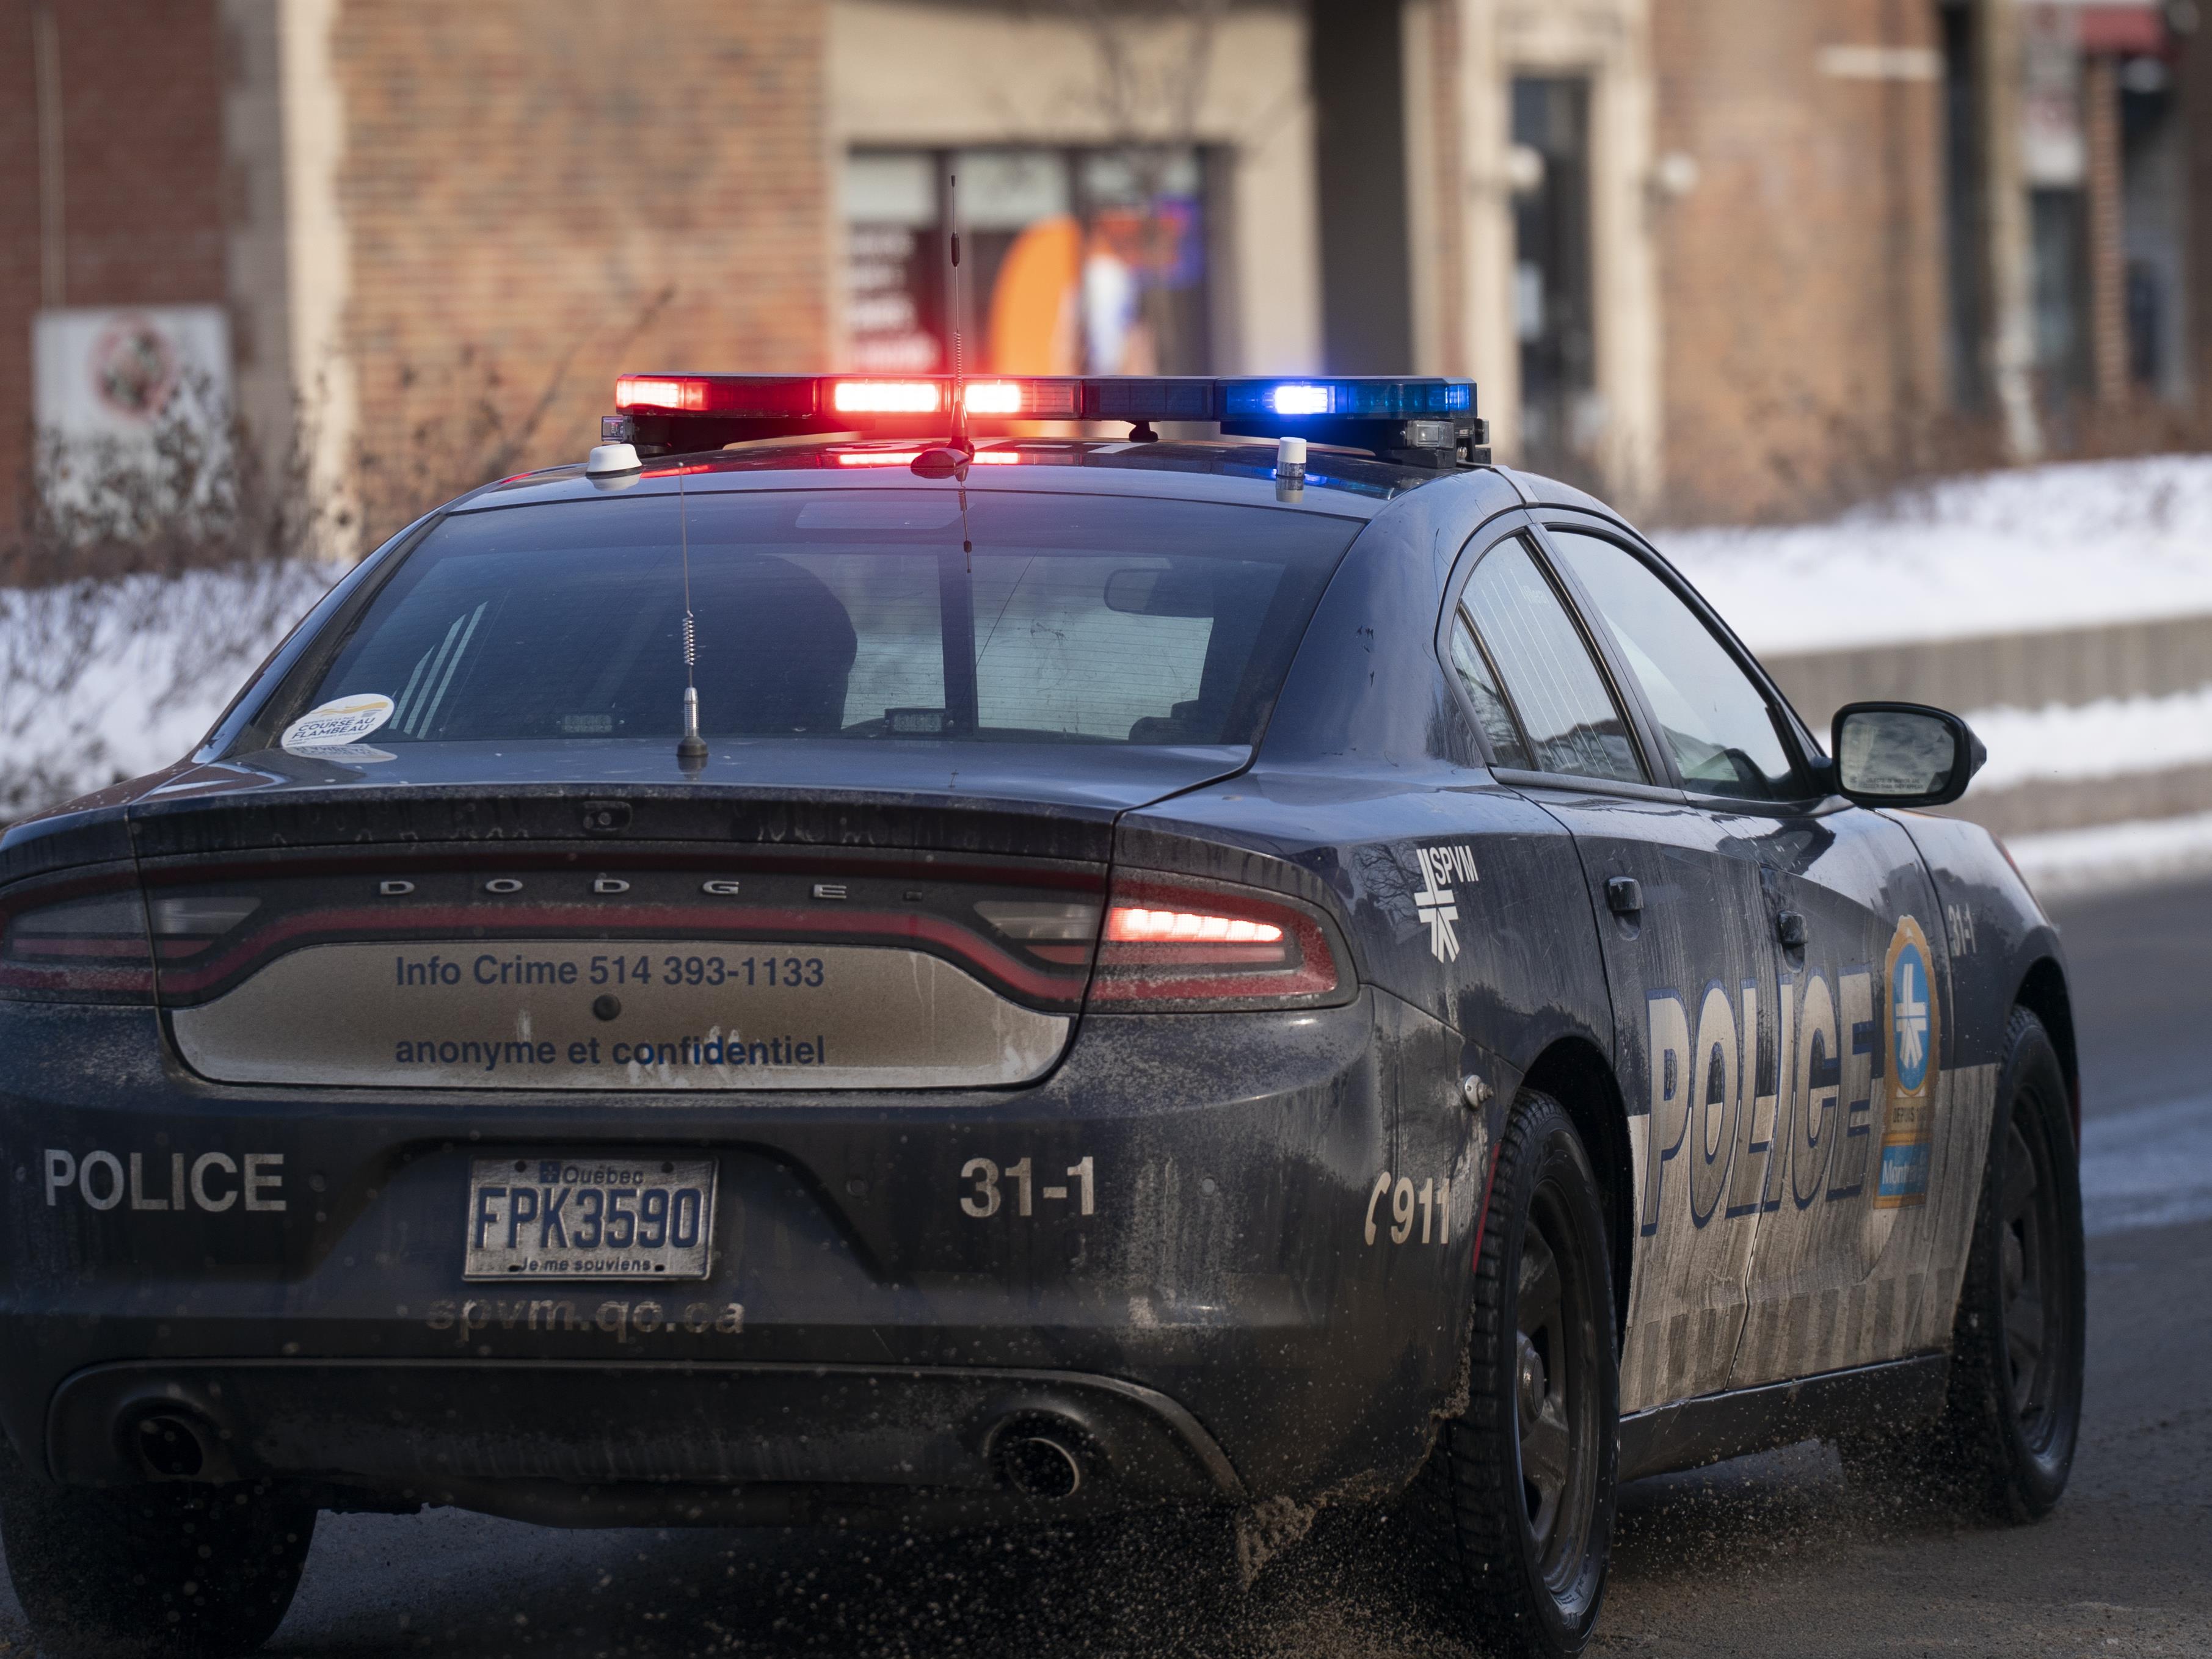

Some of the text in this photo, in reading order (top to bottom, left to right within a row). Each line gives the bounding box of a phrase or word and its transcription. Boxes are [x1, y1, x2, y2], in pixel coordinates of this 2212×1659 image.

[291, 724, 369, 739] FLAMBEAU
[298, 719, 355, 731] COURSE
[1429, 844, 1479, 885] SPVM
[380, 877, 848, 899] DODGE
[396, 956, 825, 987] Info Crime 514 393-1133
[395, 1035, 825, 1071] anonyme et confidentiel
[1640, 961, 1873, 1237] POLICE
[44, 1149, 287, 1212] POLICE
[563, 1164, 645, 1184] Québec
[960, 1156, 1094, 1218] 31-1
[474, 1188, 703, 1249] FPK3590
[1391, 1177, 1450, 1244] 911
[520, 1257, 651, 1271] Je me souviens
